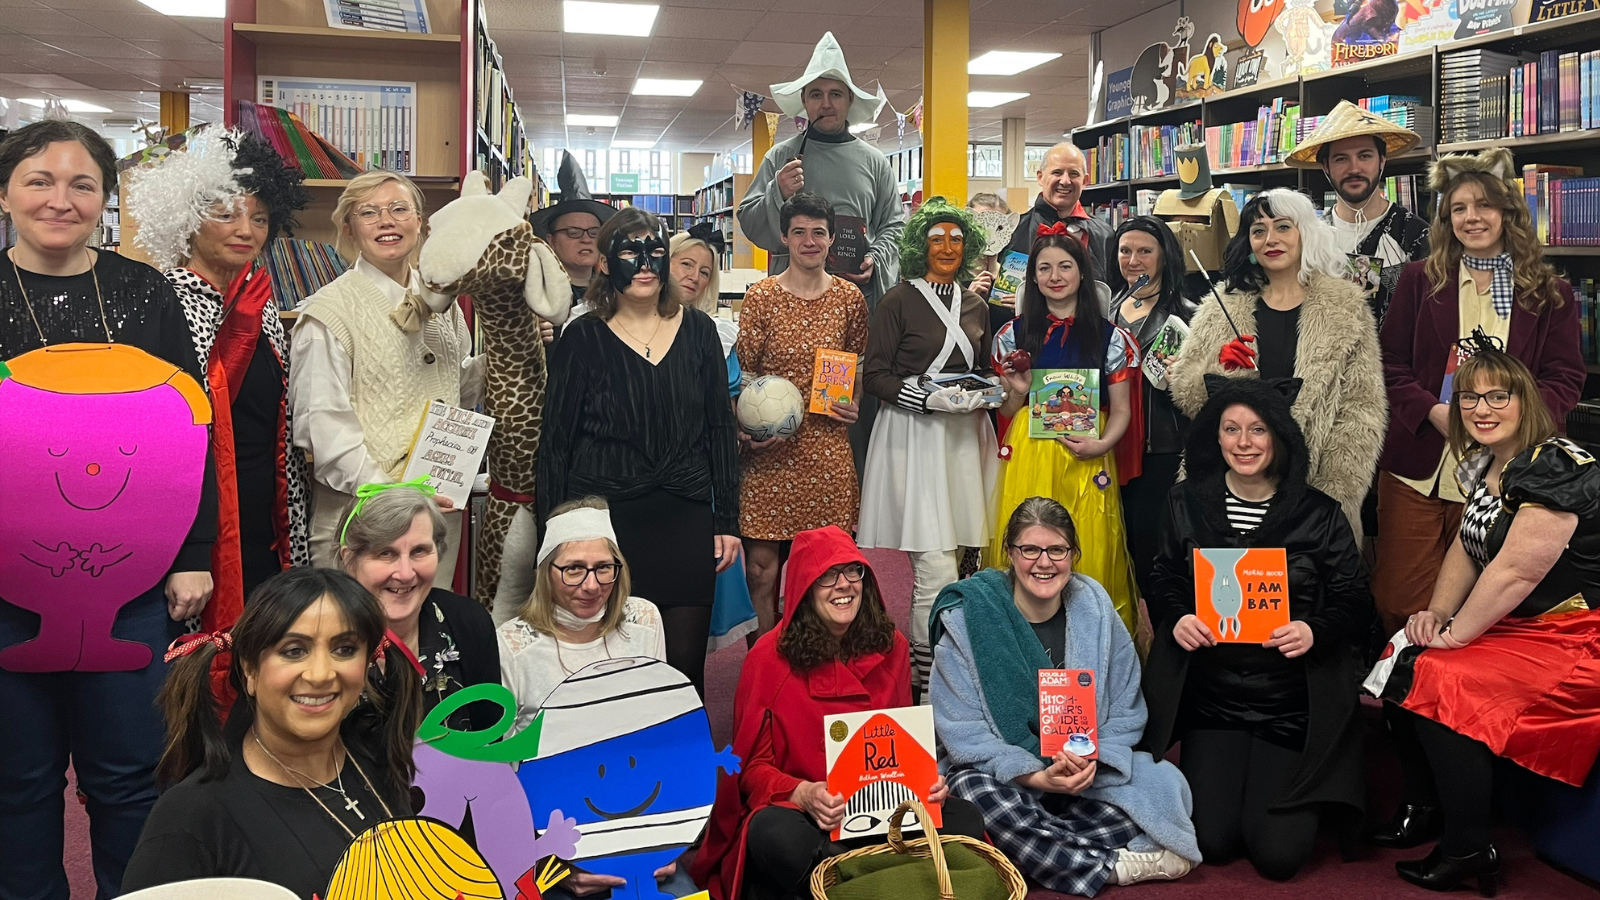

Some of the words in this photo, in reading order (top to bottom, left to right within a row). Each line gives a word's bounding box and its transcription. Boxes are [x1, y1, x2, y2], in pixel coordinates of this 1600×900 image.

[1536, 1, 1587, 20] LITTLE
[1108, 79, 1132, 94] Younge
[822, 360, 852, 377] BOY
[819, 373, 852, 386] DRESS
[1063, 373, 1083, 382] White
[429, 403, 448, 417] THE
[446, 407, 474, 425] NICE
[1247, 582, 1252, 592] I
[1257, 582, 1282, 592] AM
[1247, 598, 1282, 610] BAT
[1040, 677, 1071, 685] ADAMS
[1041, 704, 1083, 715] HIKER'S
[1041, 714, 1079, 725] GUIDE
[863, 723, 896, 739] Little
[1042, 725, 1090, 735] GALAXY
[864, 738, 900, 772] Red
[859, 772, 879, 782] Bethan
